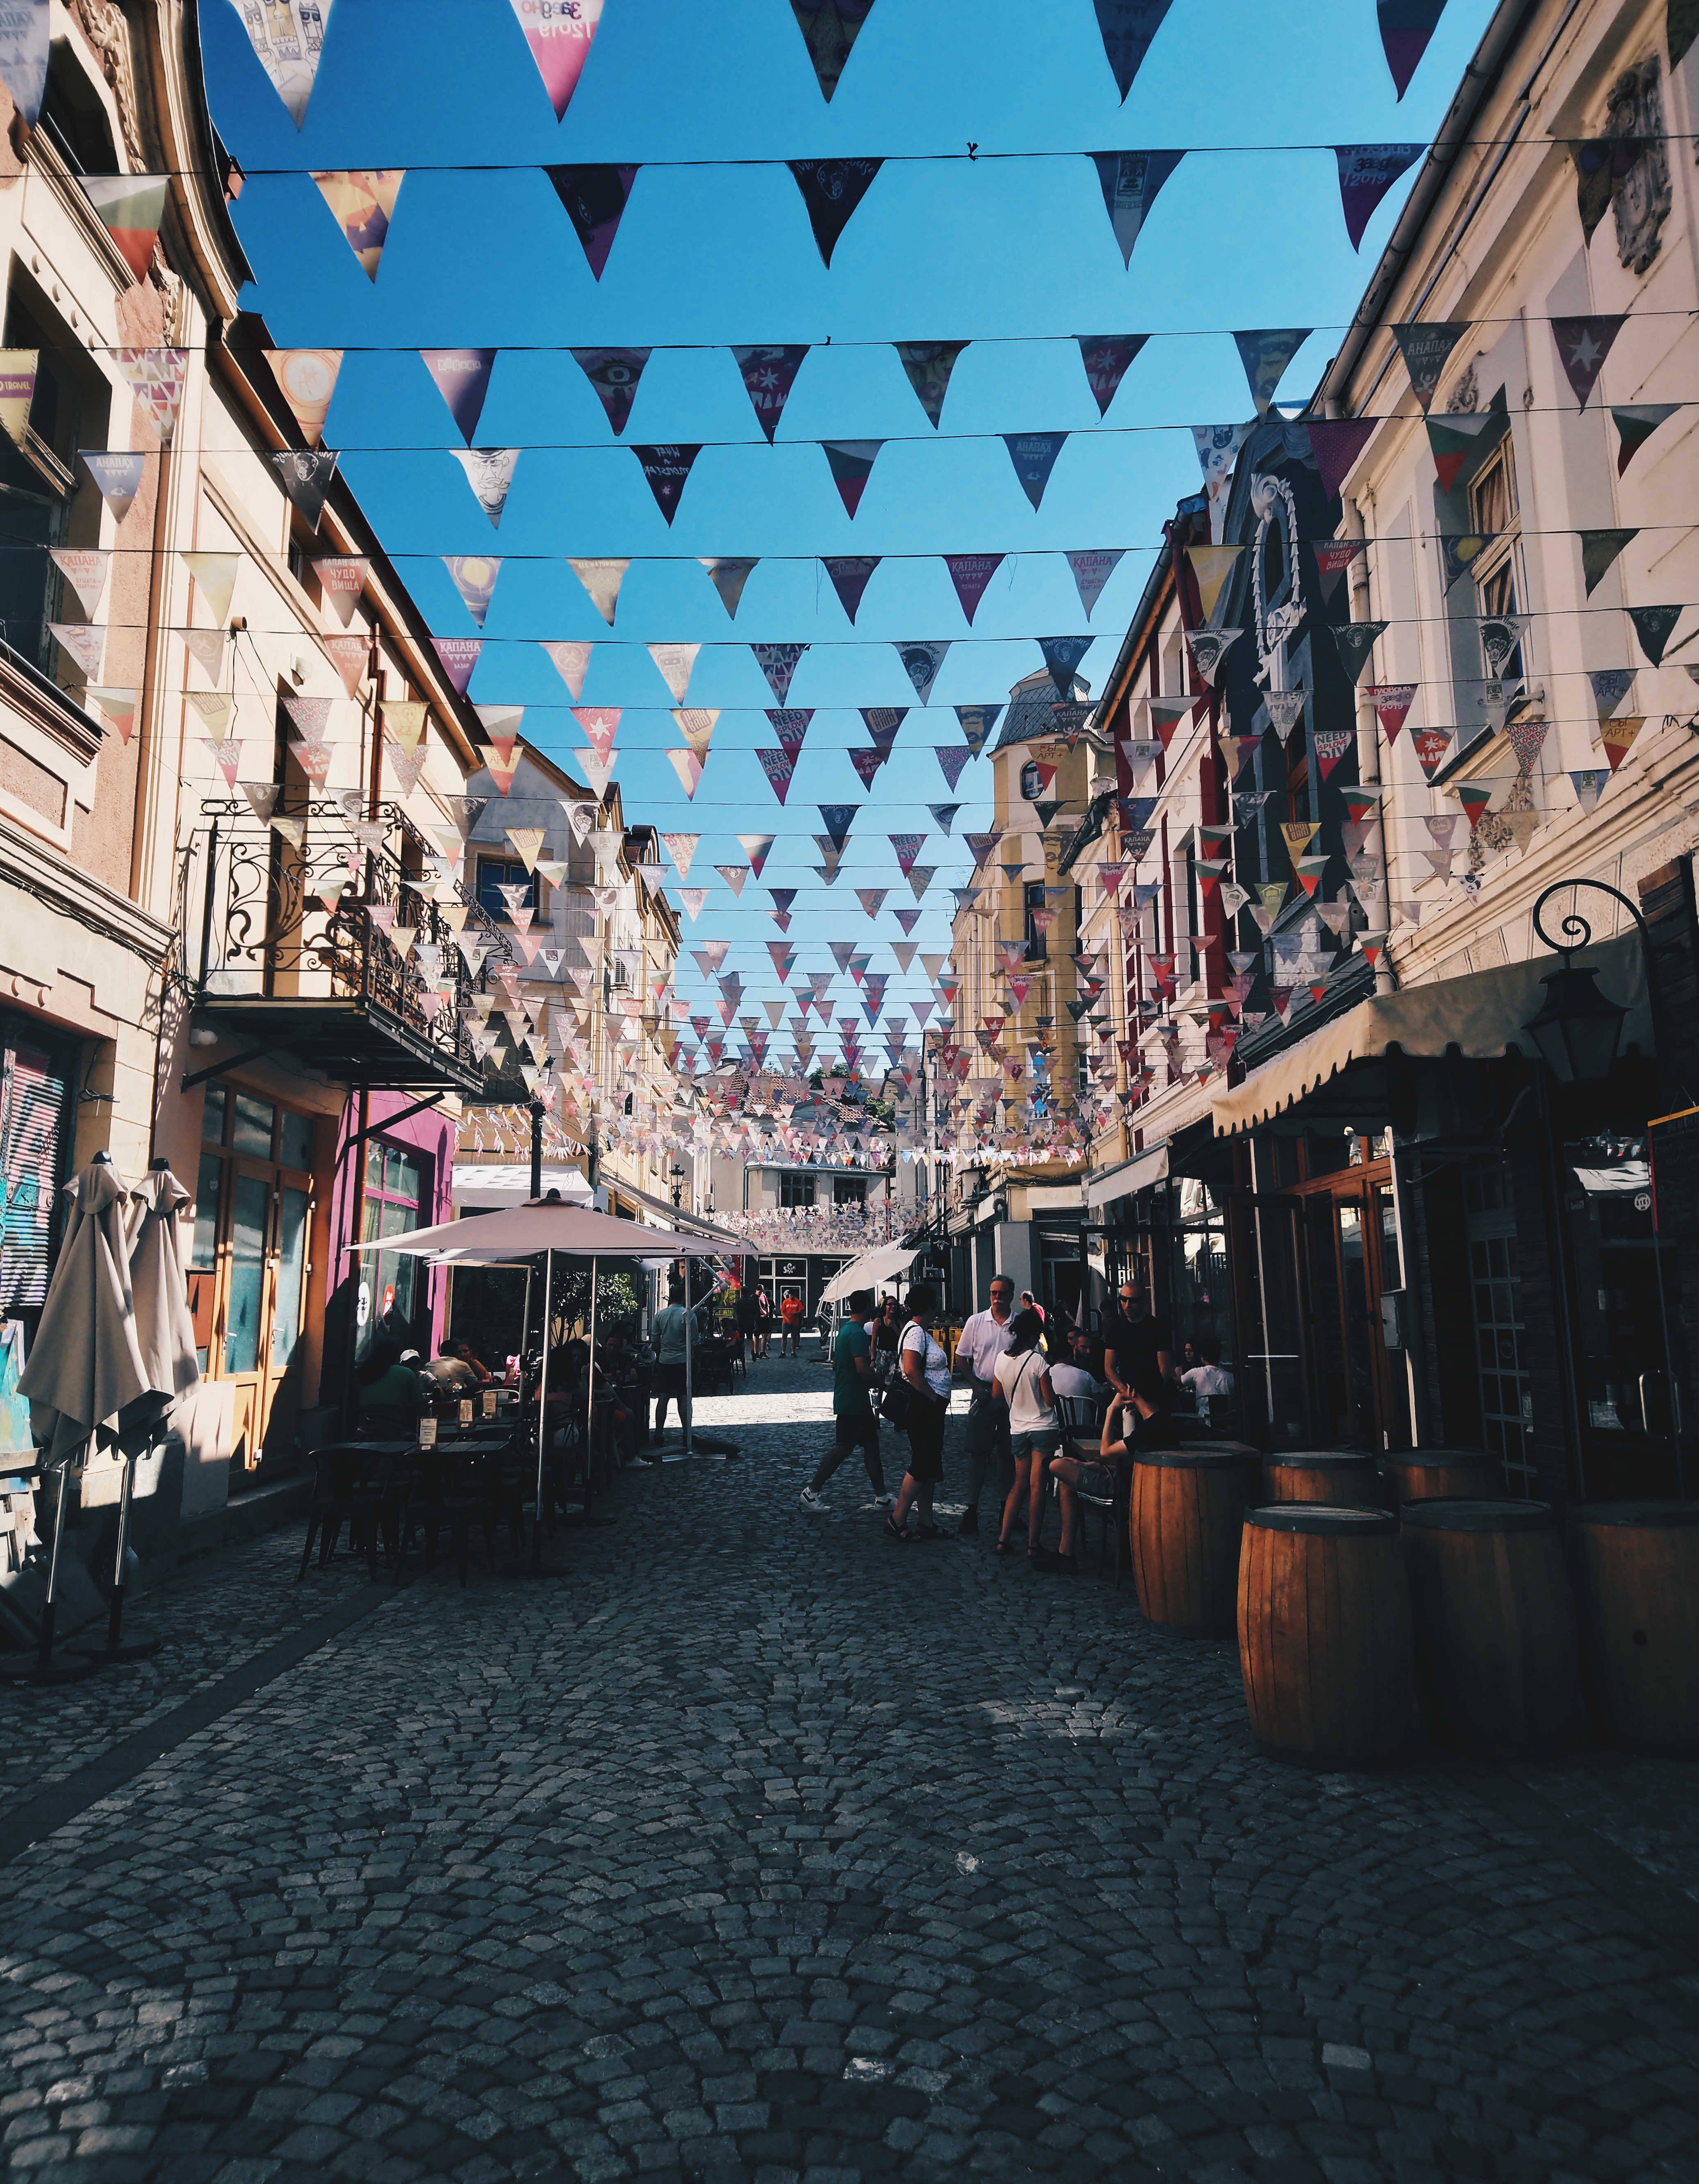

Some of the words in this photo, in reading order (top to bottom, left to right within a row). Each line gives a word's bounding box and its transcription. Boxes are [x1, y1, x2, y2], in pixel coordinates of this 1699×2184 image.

[5, 381, 31, 390] TRAVEL
[1330, 549, 1351, 560] ЧУДО
[59, 555, 102, 566] КАПАНА
[1073, 556, 1112, 567] КАПАНА
[952, 560, 991, 573] КАПАНА
[330, 569, 355, 579] ЧУДО
[332, 580, 359, 590] ВИЩА
[440, 642, 481, 653] КАПАНА
[1596, 686, 1618, 698] АРТ
[773, 711, 803, 728] NEED
[1317, 732, 1347, 745] NEED
[1605, 728, 1626, 738] АРТ
[1036, 751, 1057, 759] АРТ
[685, 835, 695, 850] 2019
[894, 836, 917, 846] NEED
